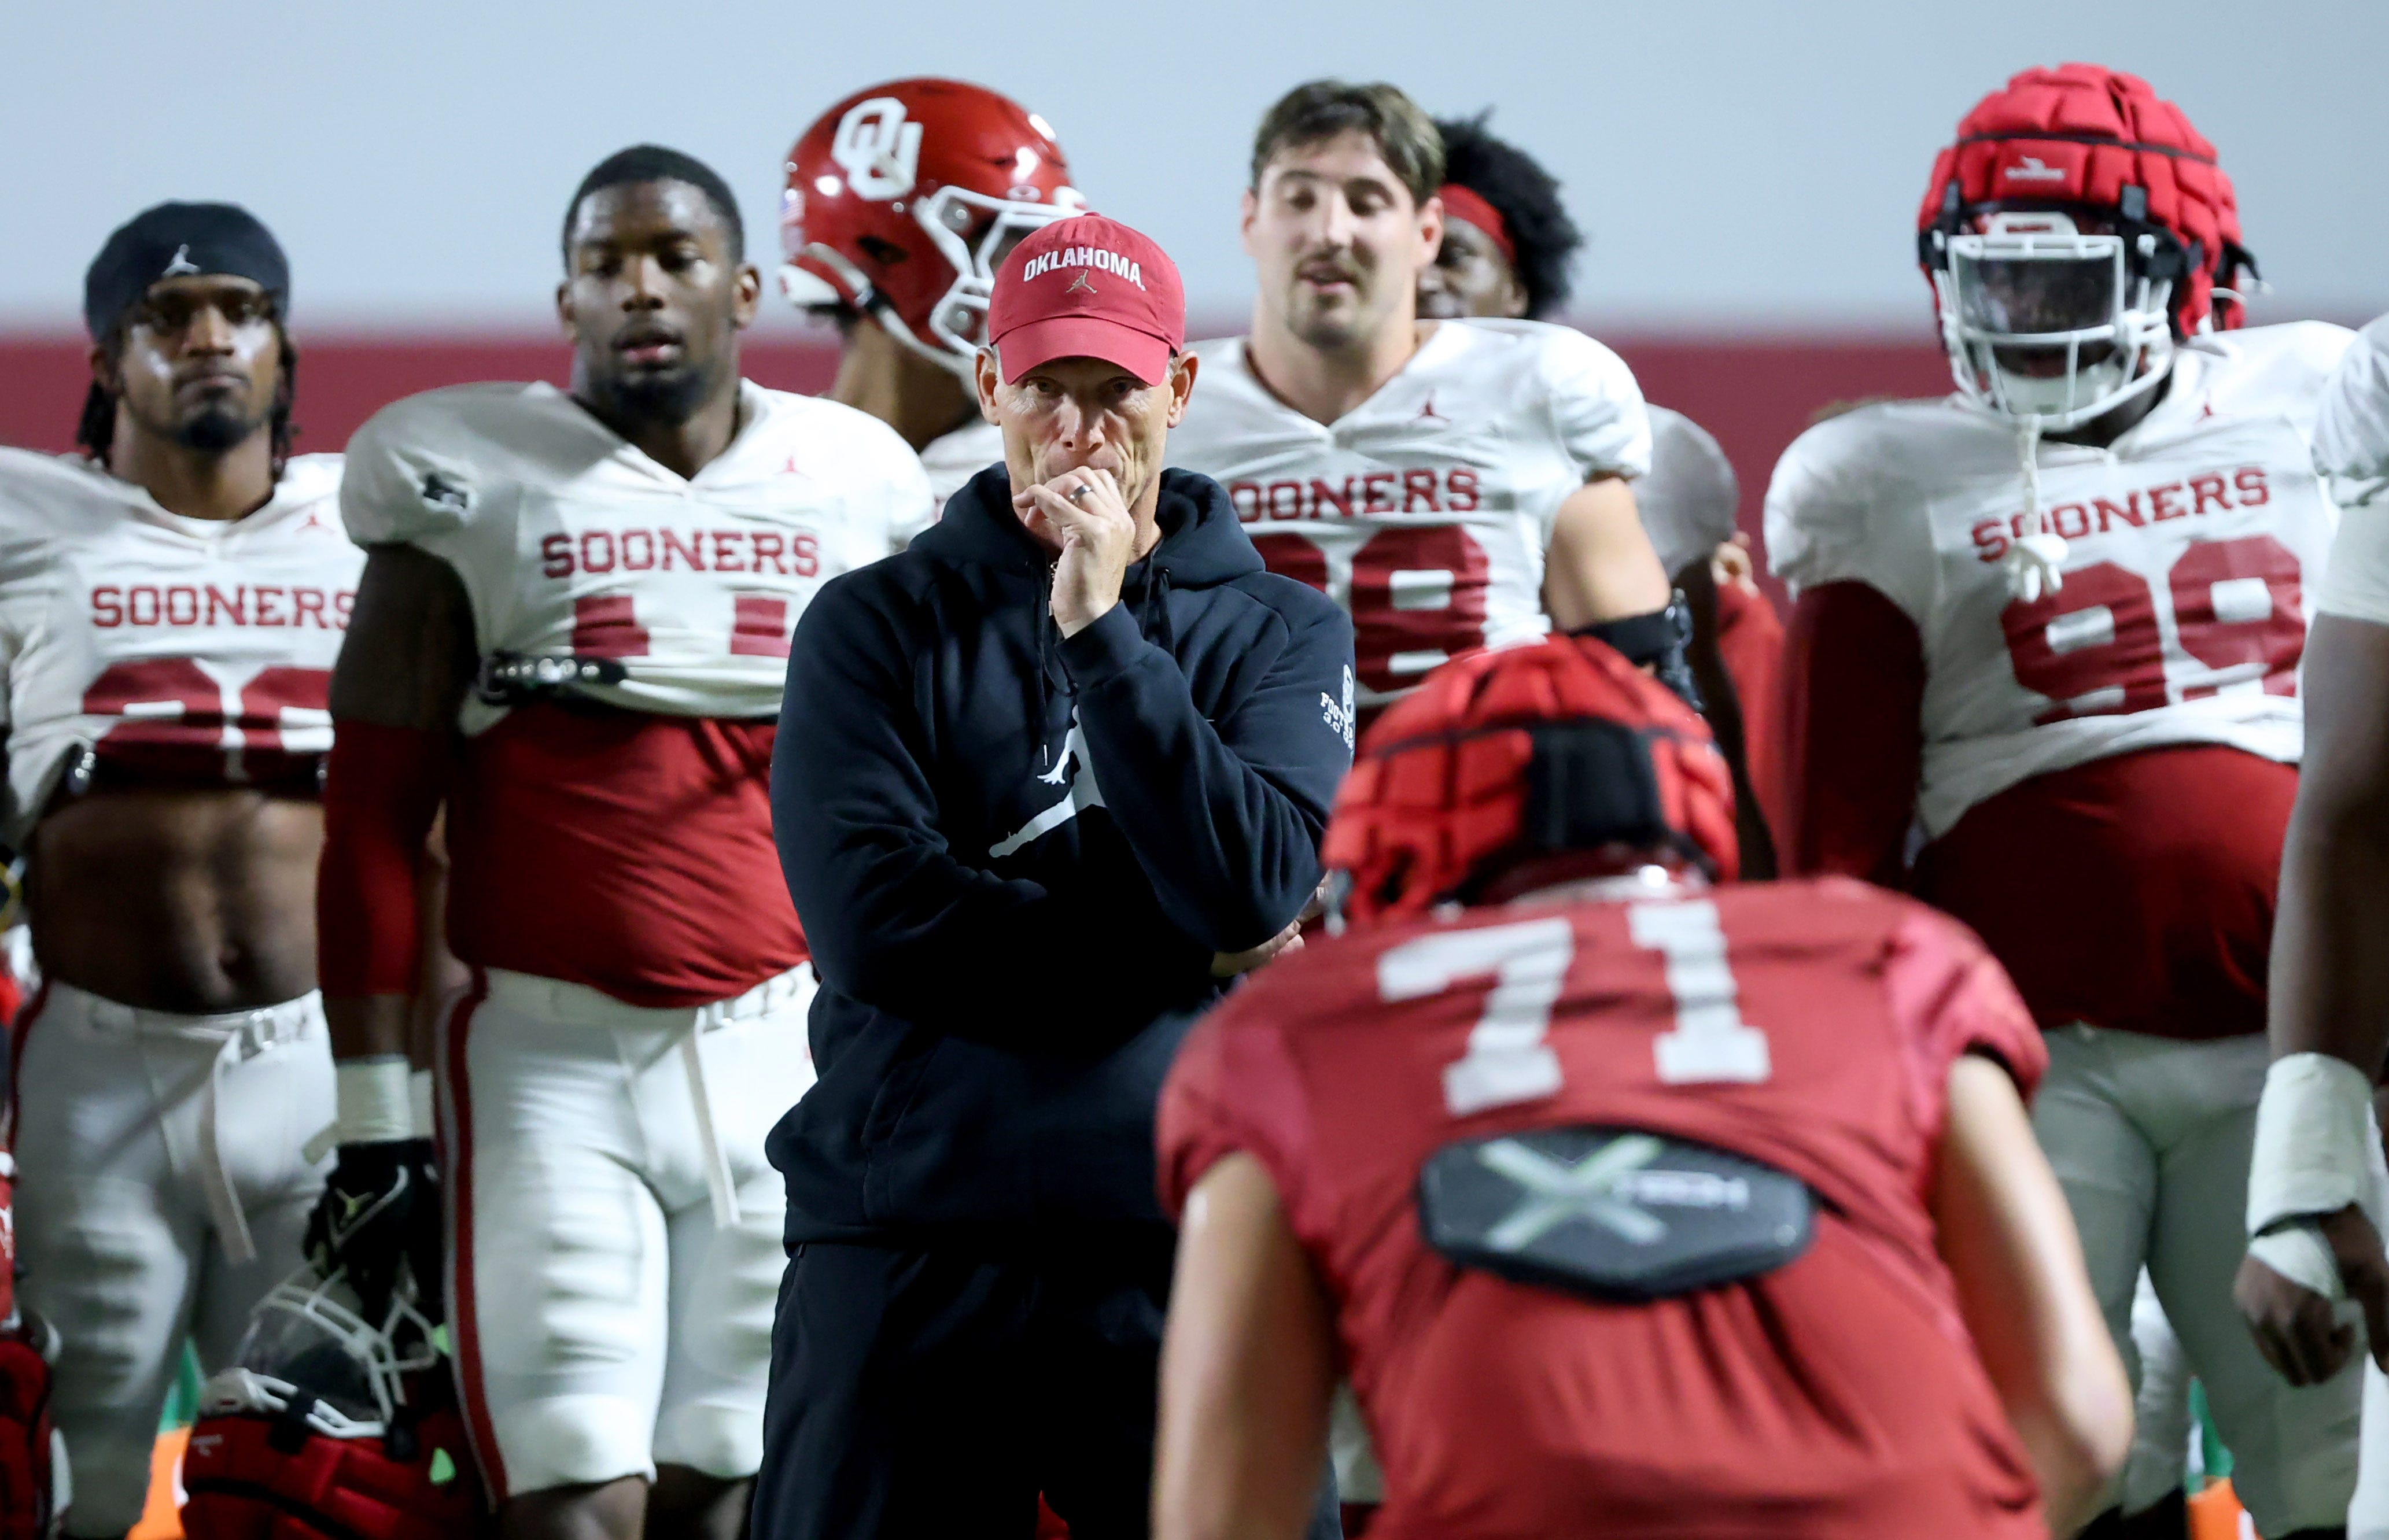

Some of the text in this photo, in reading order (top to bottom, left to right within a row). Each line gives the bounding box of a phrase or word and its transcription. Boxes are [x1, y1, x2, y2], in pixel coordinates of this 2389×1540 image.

[831, 97, 923, 201] OU
[1023, 246, 1143, 289] OKLAHOMA
[1230, 467, 1479, 522] OONERS
[543, 529, 819, 578] SOONERS
[1376, 898, 1772, 1117] 71
